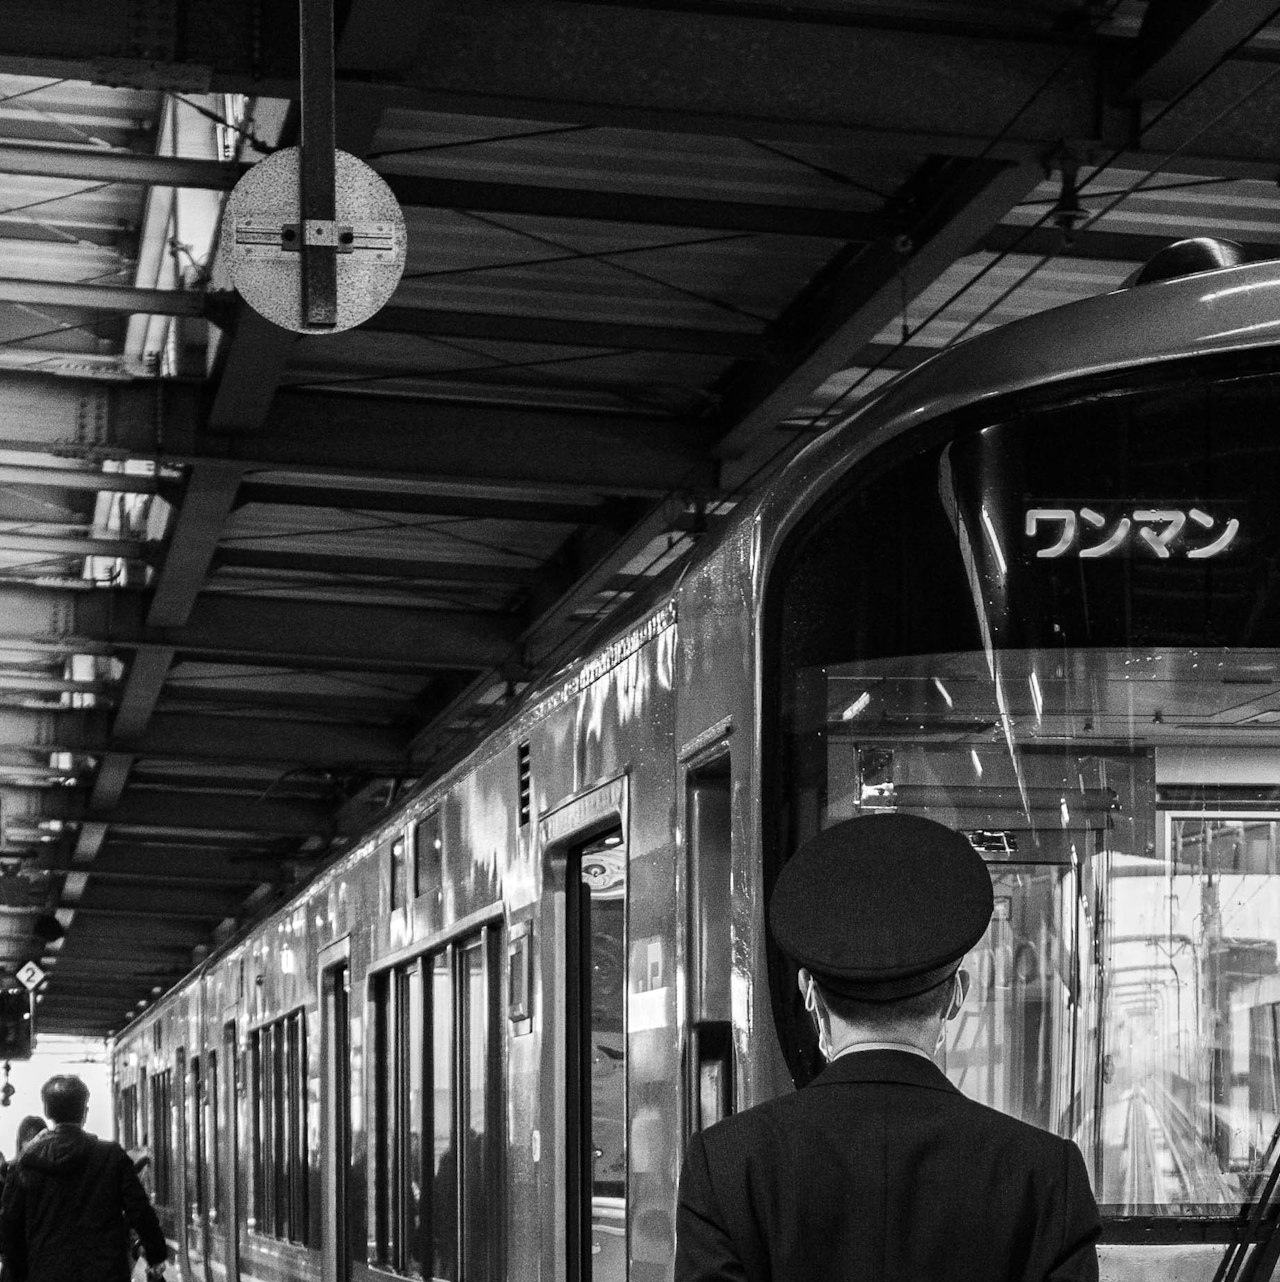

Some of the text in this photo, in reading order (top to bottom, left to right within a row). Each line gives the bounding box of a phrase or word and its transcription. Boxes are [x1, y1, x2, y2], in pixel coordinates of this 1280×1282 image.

[1026, 507, 1239, 559] ワンマン
[24, 967, 36, 982] 2
